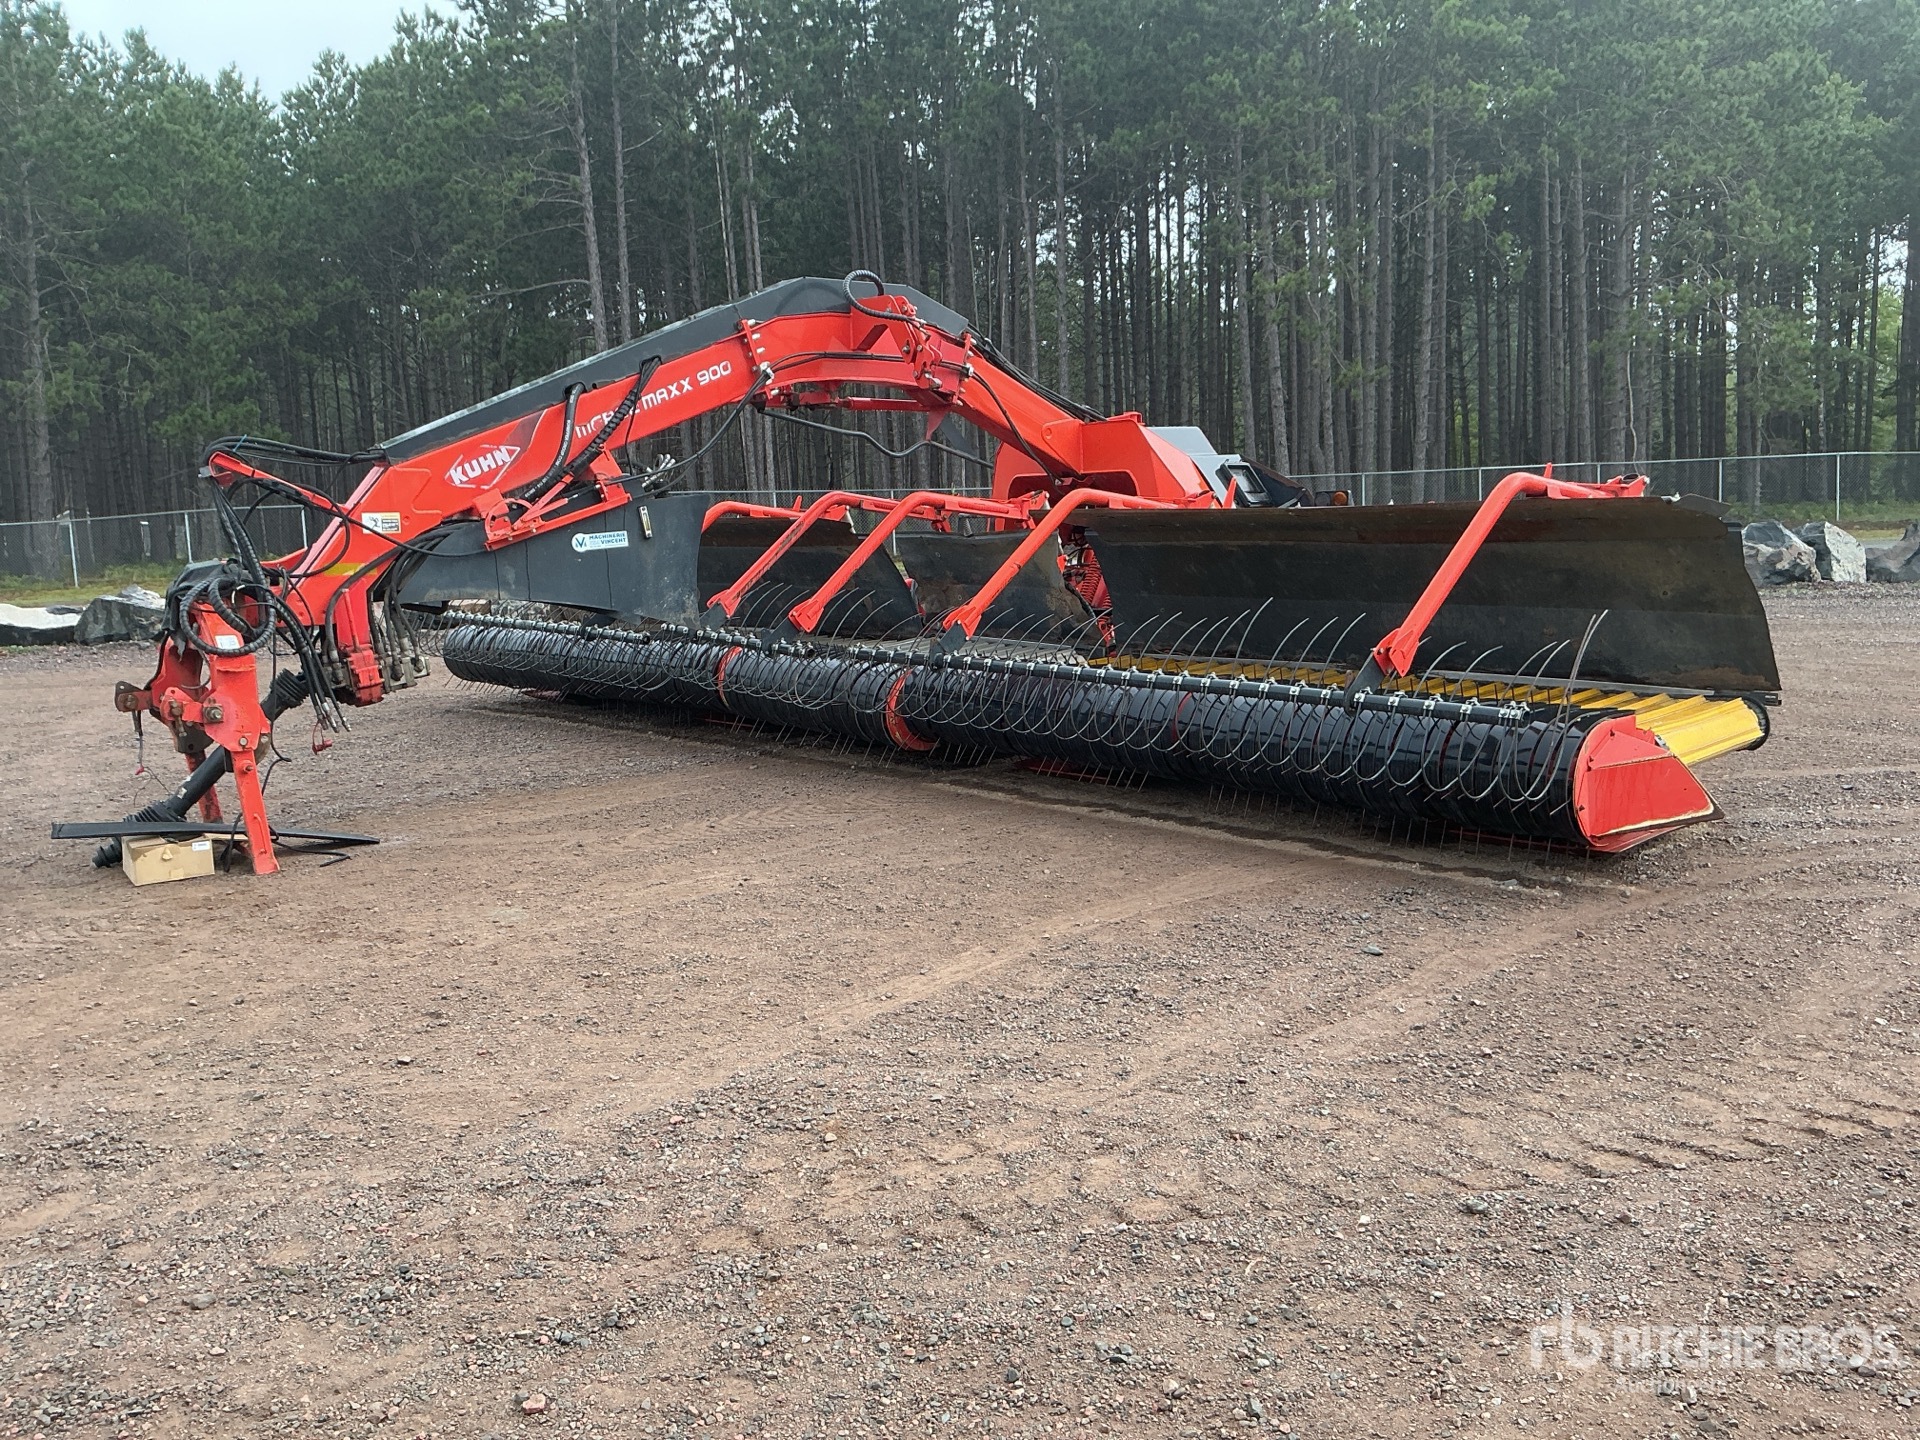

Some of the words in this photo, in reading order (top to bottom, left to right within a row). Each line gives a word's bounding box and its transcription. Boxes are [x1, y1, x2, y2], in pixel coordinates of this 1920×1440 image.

[641, 376, 693, 410] MAXX
[697, 360, 731, 386] 900
[450, 446, 511, 485] KUHN
